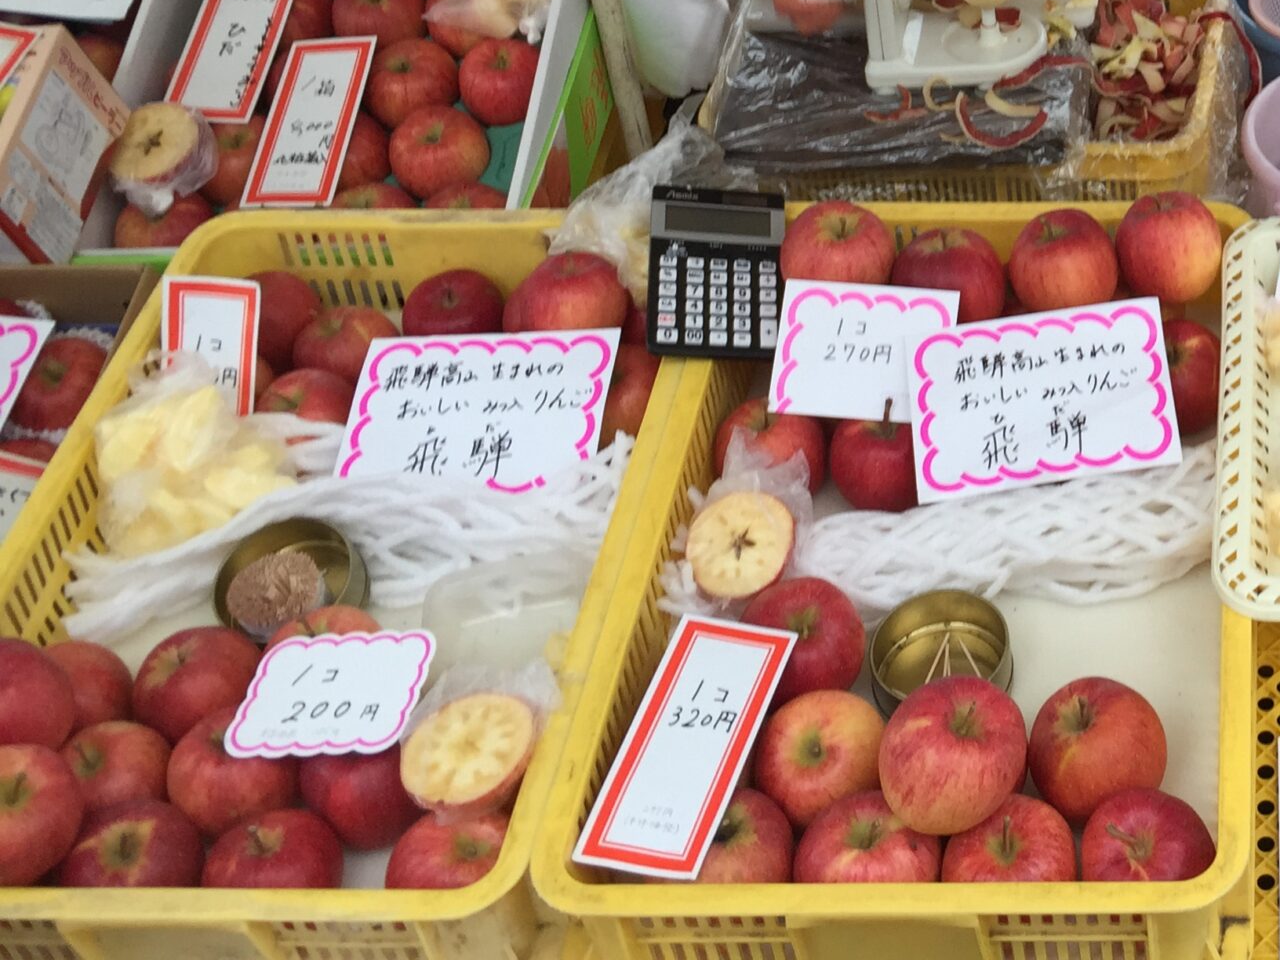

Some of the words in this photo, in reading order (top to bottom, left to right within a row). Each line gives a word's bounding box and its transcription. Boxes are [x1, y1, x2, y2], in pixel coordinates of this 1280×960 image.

[836, 318, 868, 337] 1コ
[195, 334, 223, 352] 1コ
[823, 343, 893, 364] 270円
[292, 663, 340, 686] 1コ
[691, 678, 730, 704] 1コ
[280, 700, 380, 724] 200円
[667, 705, 738, 734] 320円
